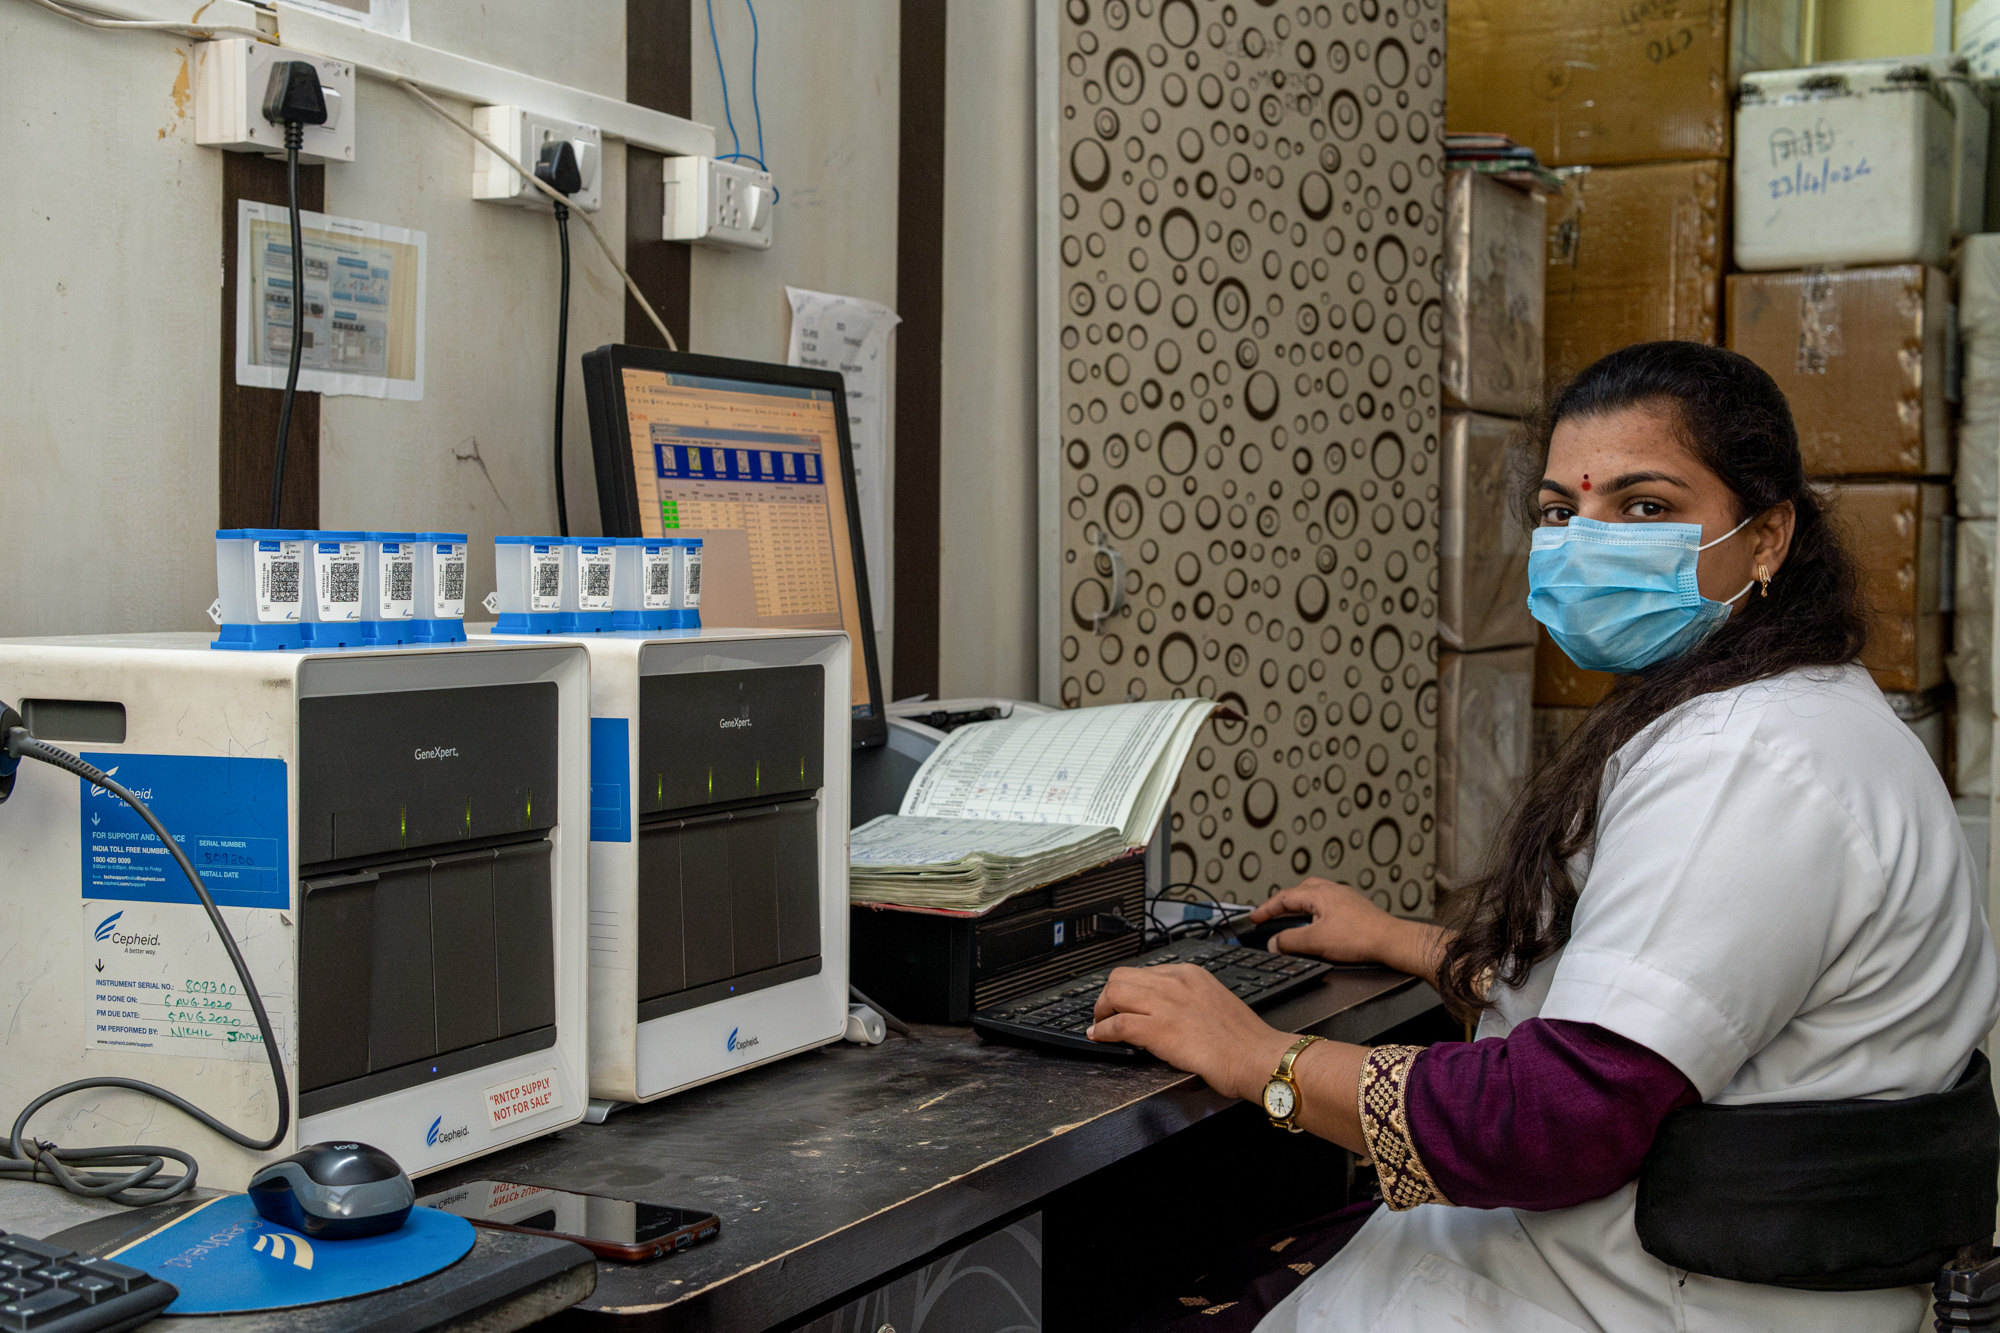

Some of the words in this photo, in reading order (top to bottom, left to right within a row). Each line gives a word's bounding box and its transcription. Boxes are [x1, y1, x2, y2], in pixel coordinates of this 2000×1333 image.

[107, 787, 154, 801] Cheid.
[92, 831, 105, 840] FOR
[107, 832, 139, 841] SUPPORT
[140, 833, 156, 841] AND
[199, 839, 220, 847] SERIAL
[220, 840, 247, 848] NUMBER
[125, 846, 141, 854] FREE
[141, 847, 170, 855] NUMBER:
[199, 870, 223, 878] INSTALL
[223, 871, 239, 879] DATE
[111, 932, 161, 947] Cepheid.
[96, 979, 136, 988] INSTRUMENT
[137, 981, 160, 990] SERIAL
[96, 994, 106, 1002] PM
[107, 995, 126, 1003] DONE
[126, 996, 138, 1004] ON:
[203, 998, 233, 1010] 2020
[96, 1009, 107, 1017] PM
[107, 1010, 121, 1018] DUE
[121, 1011, 141, 1019] DATE:
[208, 1013, 241, 1027] 2020
[107, 1025, 148, 1035] PERFORMED
[148, 1027, 159, 1036] BY:
[521, 1077, 550, 1096] SUPPLY
[493, 1106, 511, 1122] NOT
[512, 1100, 530, 1115] FOR
